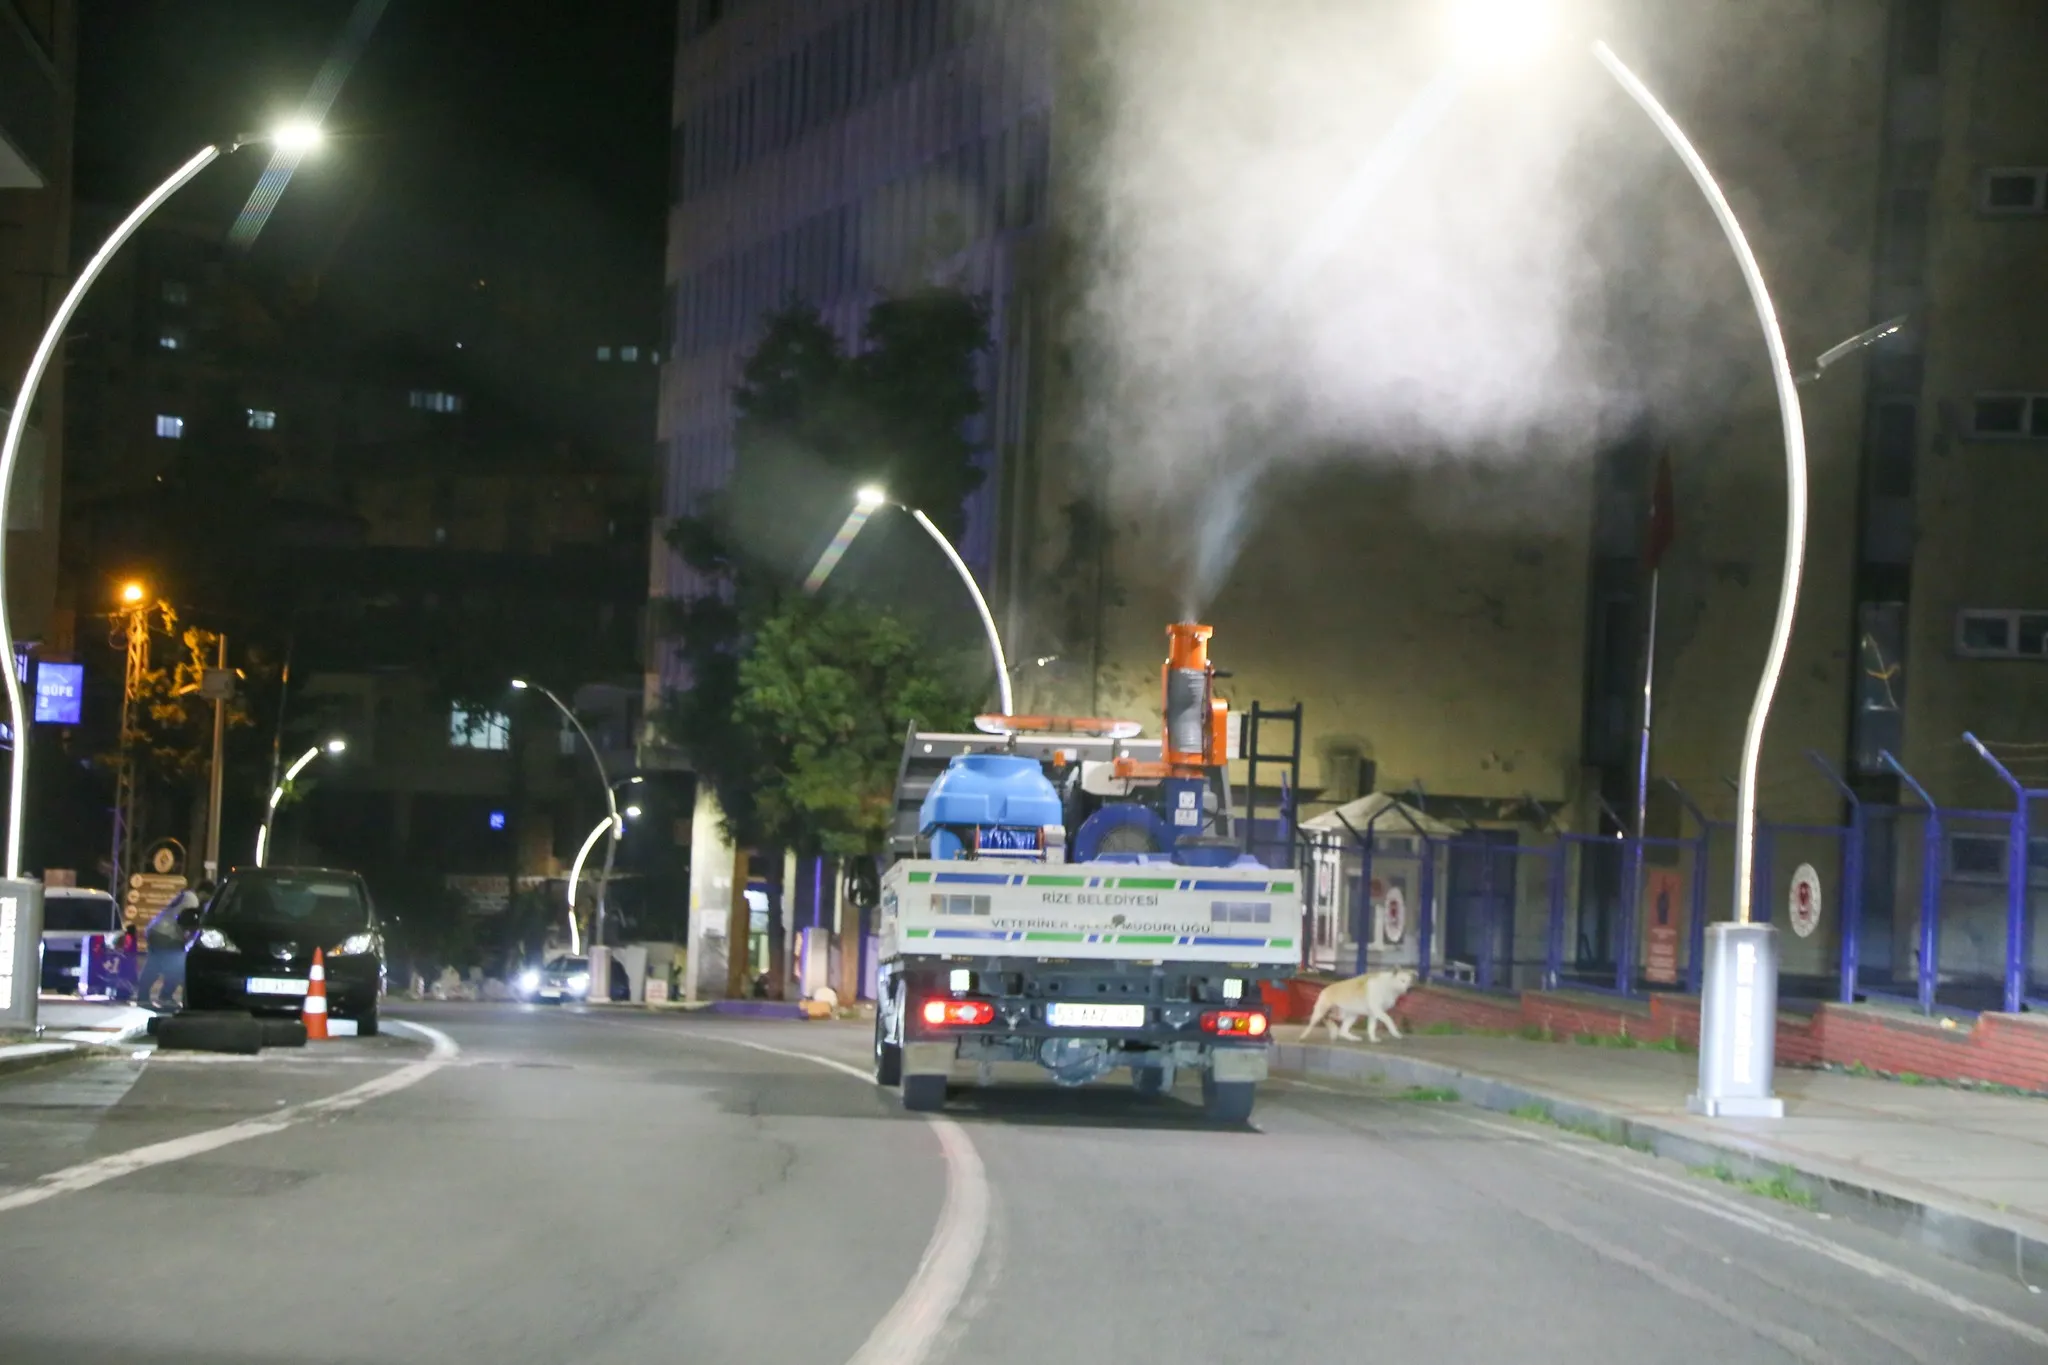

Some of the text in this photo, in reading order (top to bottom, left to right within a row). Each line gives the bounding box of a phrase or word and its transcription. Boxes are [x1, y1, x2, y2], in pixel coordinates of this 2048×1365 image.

[1042, 892, 1158, 906] RİZE BELEDİYESİ
[992, 917, 1069, 929] VETERİNER
